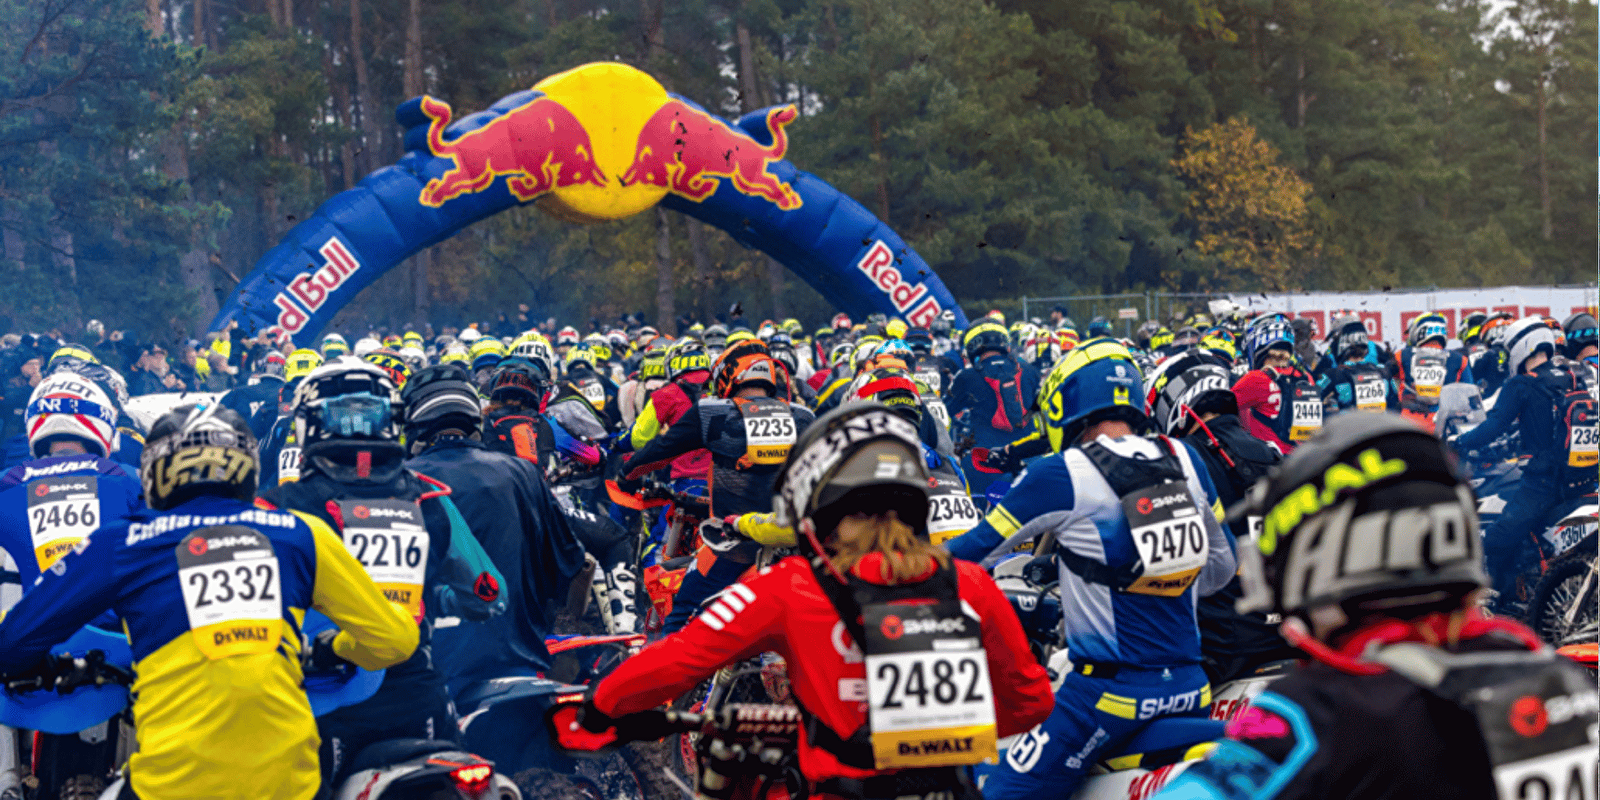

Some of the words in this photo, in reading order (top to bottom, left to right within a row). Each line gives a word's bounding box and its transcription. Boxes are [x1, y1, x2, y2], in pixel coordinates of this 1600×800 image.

[286, 235, 361, 314] Bull
[857, 239, 928, 313] Red
[1416, 369, 1443, 381] 2209
[1358, 384, 1384, 400] 2266
[1295, 403, 1321, 420] 2444
[748, 418, 794, 437] 2235
[1573, 428, 1599, 445] 236
[33, 503, 96, 535] 2466
[929, 497, 976, 522] 2348
[351, 533, 422, 568] 2216
[1141, 521, 1204, 565] 2470
[189, 564, 275, 608] 2332
[878, 659, 984, 710] 2482
[1138, 690, 1200, 720] SHOT
